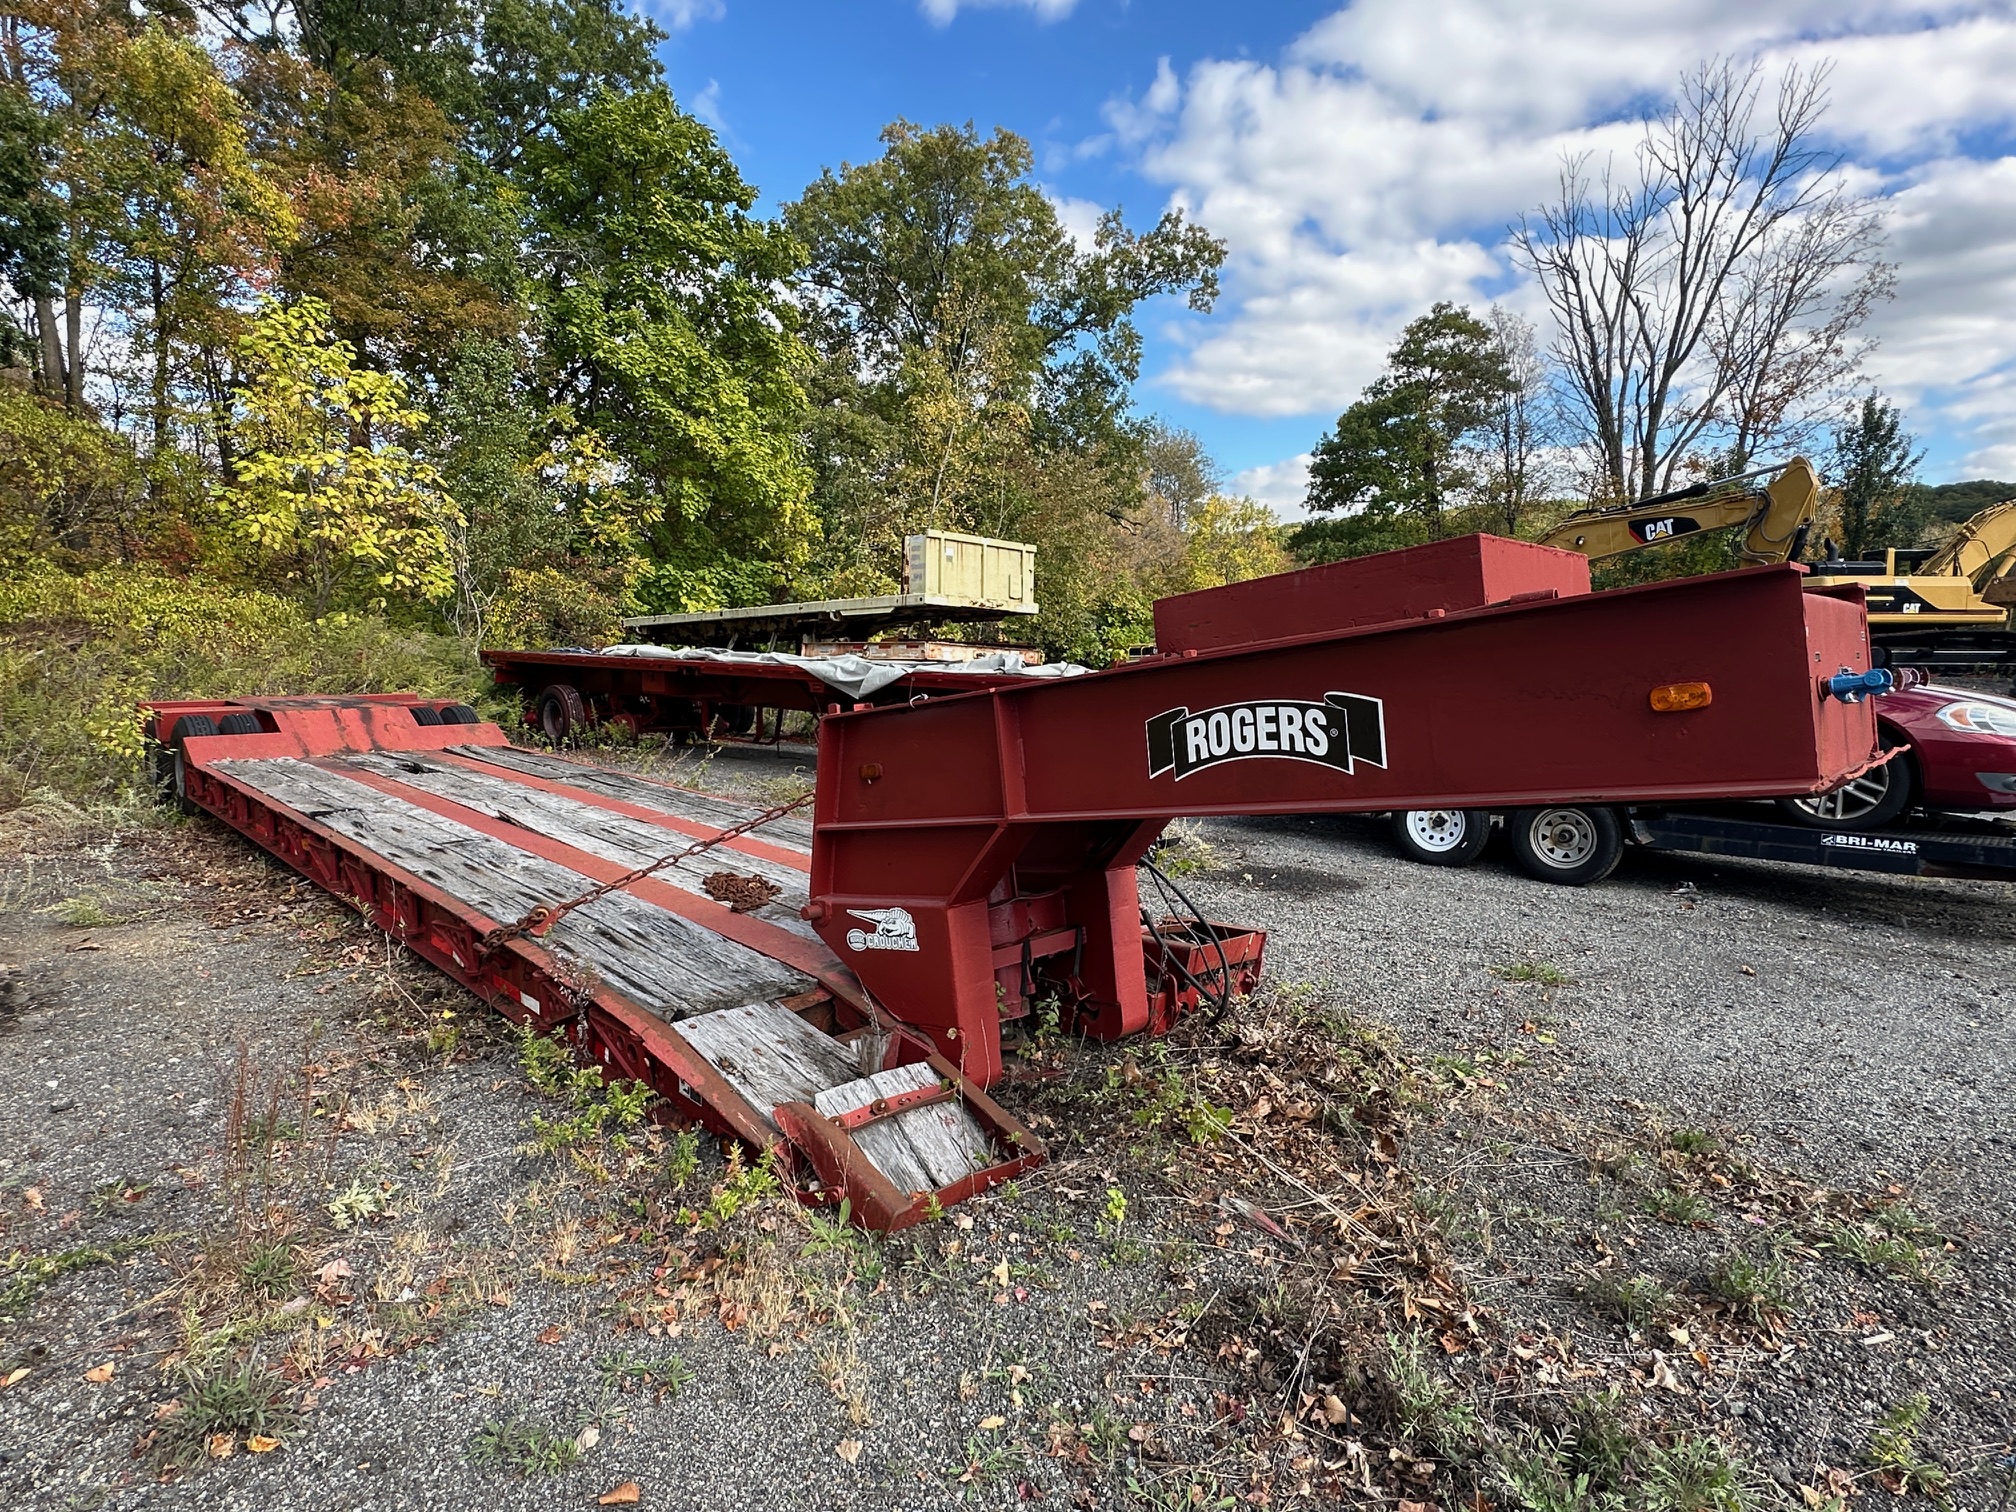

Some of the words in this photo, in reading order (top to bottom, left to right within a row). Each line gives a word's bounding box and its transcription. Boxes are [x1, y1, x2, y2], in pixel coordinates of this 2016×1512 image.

[1645, 518, 1674, 541] CAT
[1902, 603, 1921, 614] CAT
[1185, 706, 1329, 764] ROGERS
[1835, 835, 1917, 851] BRI-MAR
